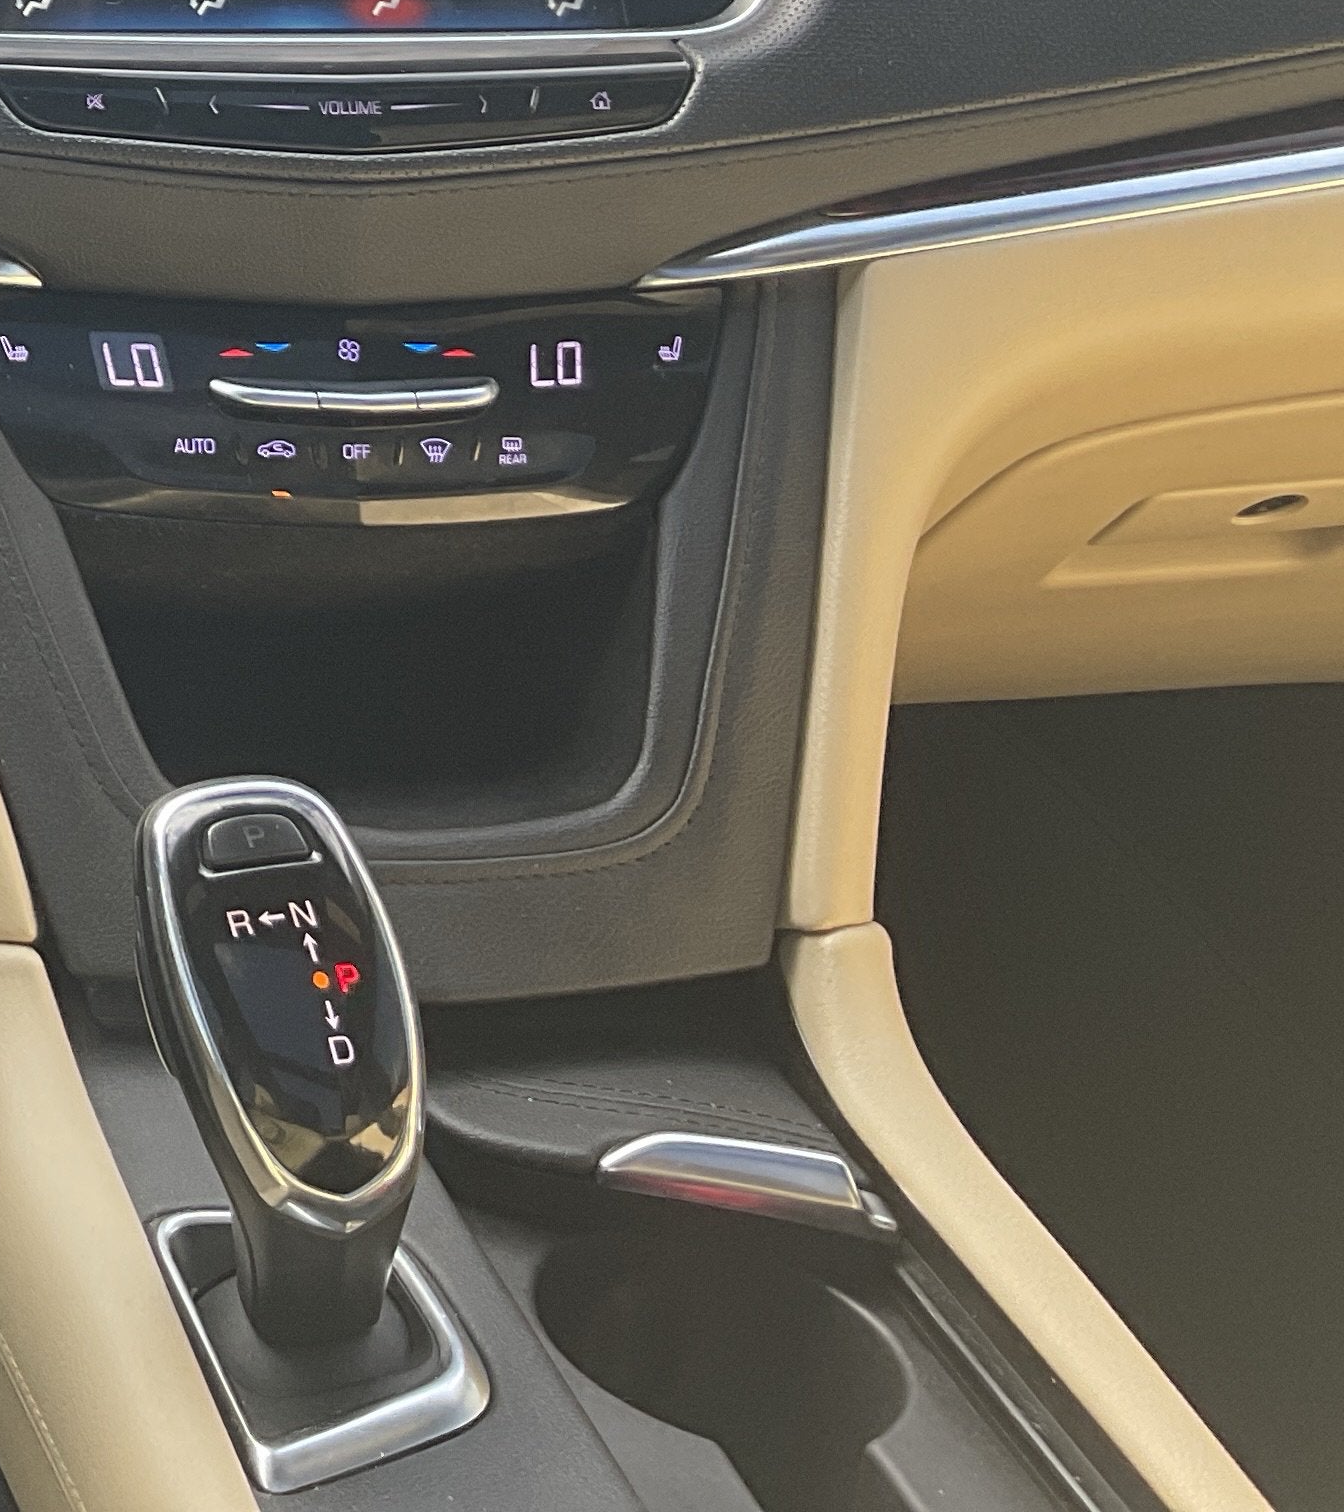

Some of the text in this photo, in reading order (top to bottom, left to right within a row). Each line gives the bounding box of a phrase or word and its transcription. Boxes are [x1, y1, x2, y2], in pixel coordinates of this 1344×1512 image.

[318, 99, 382, 116] VOLUME
[102, 341, 163, 388] LO
[529, 340, 583, 388] LO
[173, 437, 216, 455] AUTO
[342, 443, 373, 461] OFF
[498, 453, 527, 466] REAR
[241, 824, 265, 849] P
[225, 908, 257, 938] R
[287, 899, 319, 929] N
[335, 962, 359, 993] P
[327, 1034, 355, 1065] D
